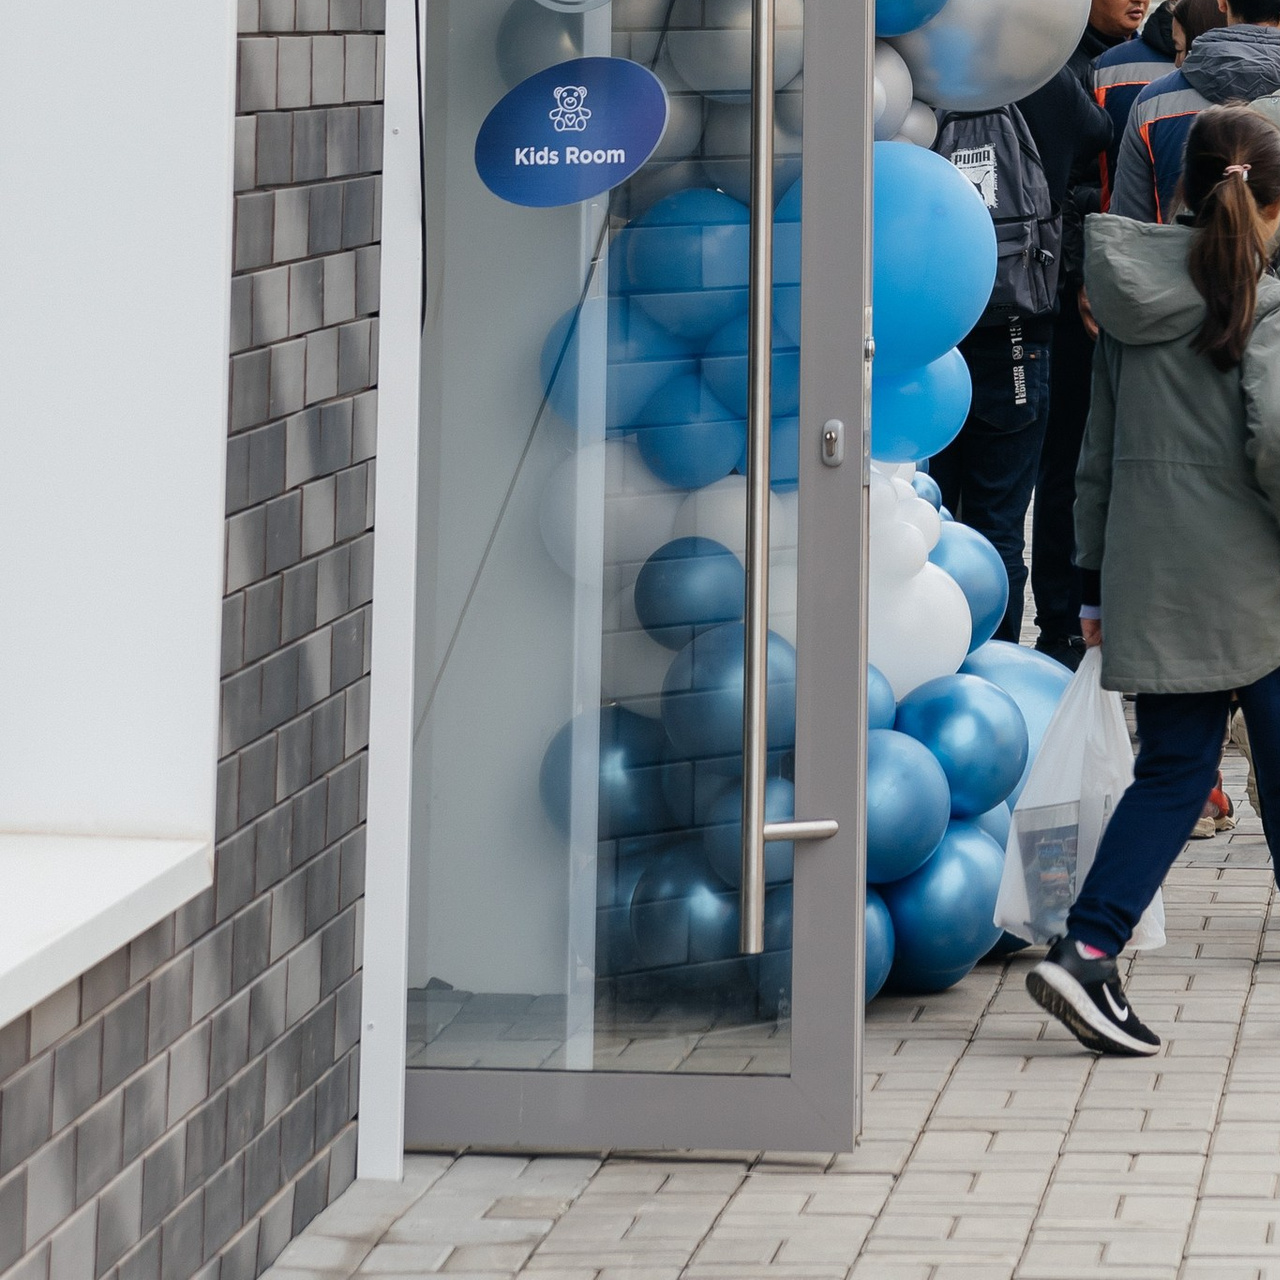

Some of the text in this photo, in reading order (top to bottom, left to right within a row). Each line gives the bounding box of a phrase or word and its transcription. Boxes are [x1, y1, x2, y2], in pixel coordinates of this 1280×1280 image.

[515, 146, 626, 166] Kids Room
[954, 150, 991, 166] PUMA
[1013, 366, 1021, 399] LIMITED
[1018, 365, 1027, 399] EDITION
